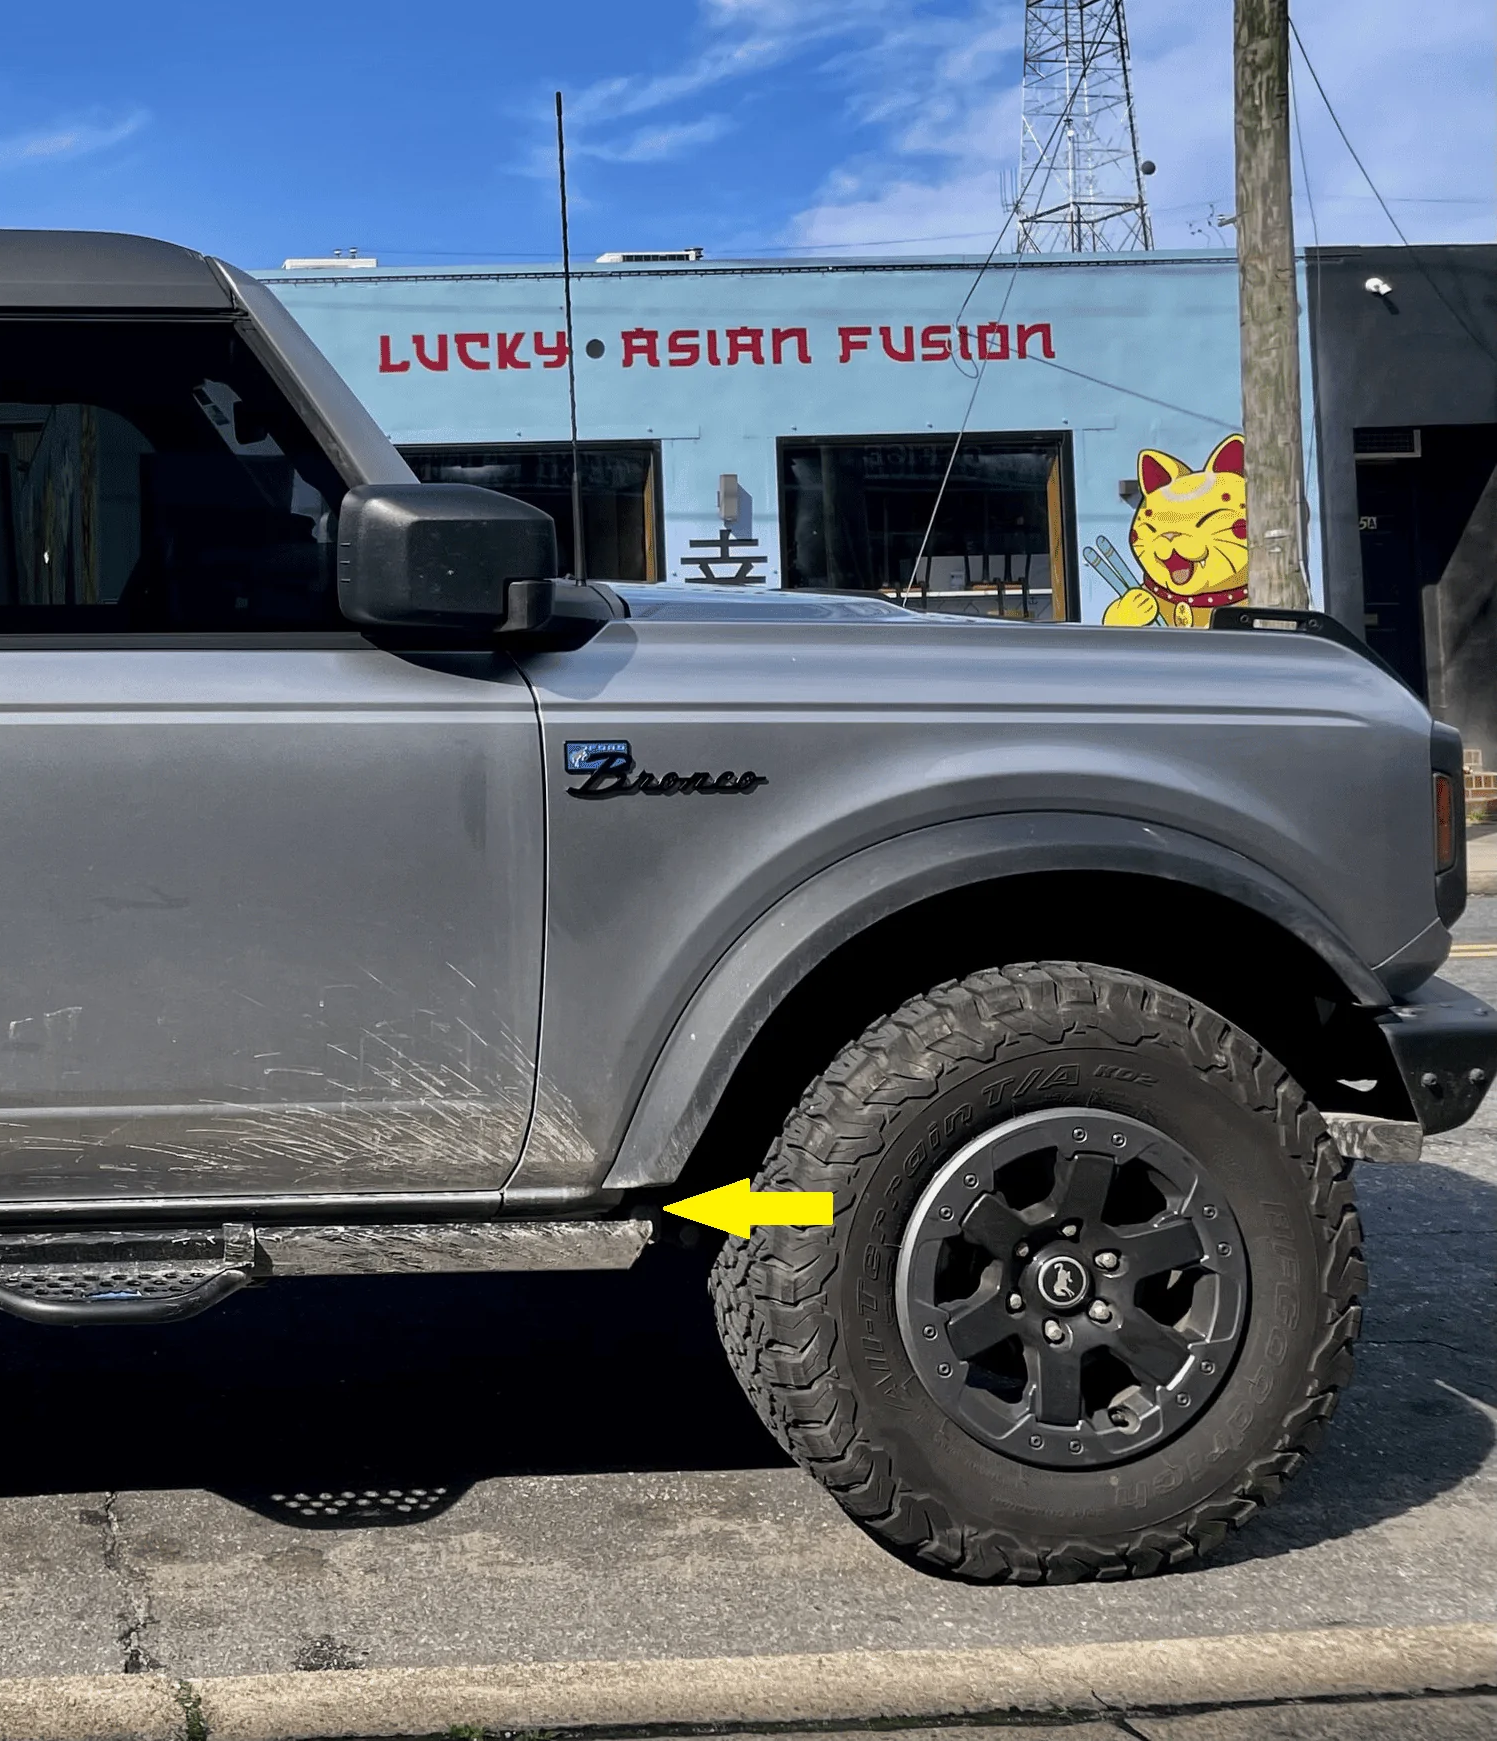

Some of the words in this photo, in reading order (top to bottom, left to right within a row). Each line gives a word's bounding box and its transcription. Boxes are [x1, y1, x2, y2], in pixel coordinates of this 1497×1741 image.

[379, 331, 570, 374] LUCKY
[621, 327, 811, 368] ASIAN
[838, 322, 1055, 364] FUSION
[566, 751, 769, 800] Bronco
